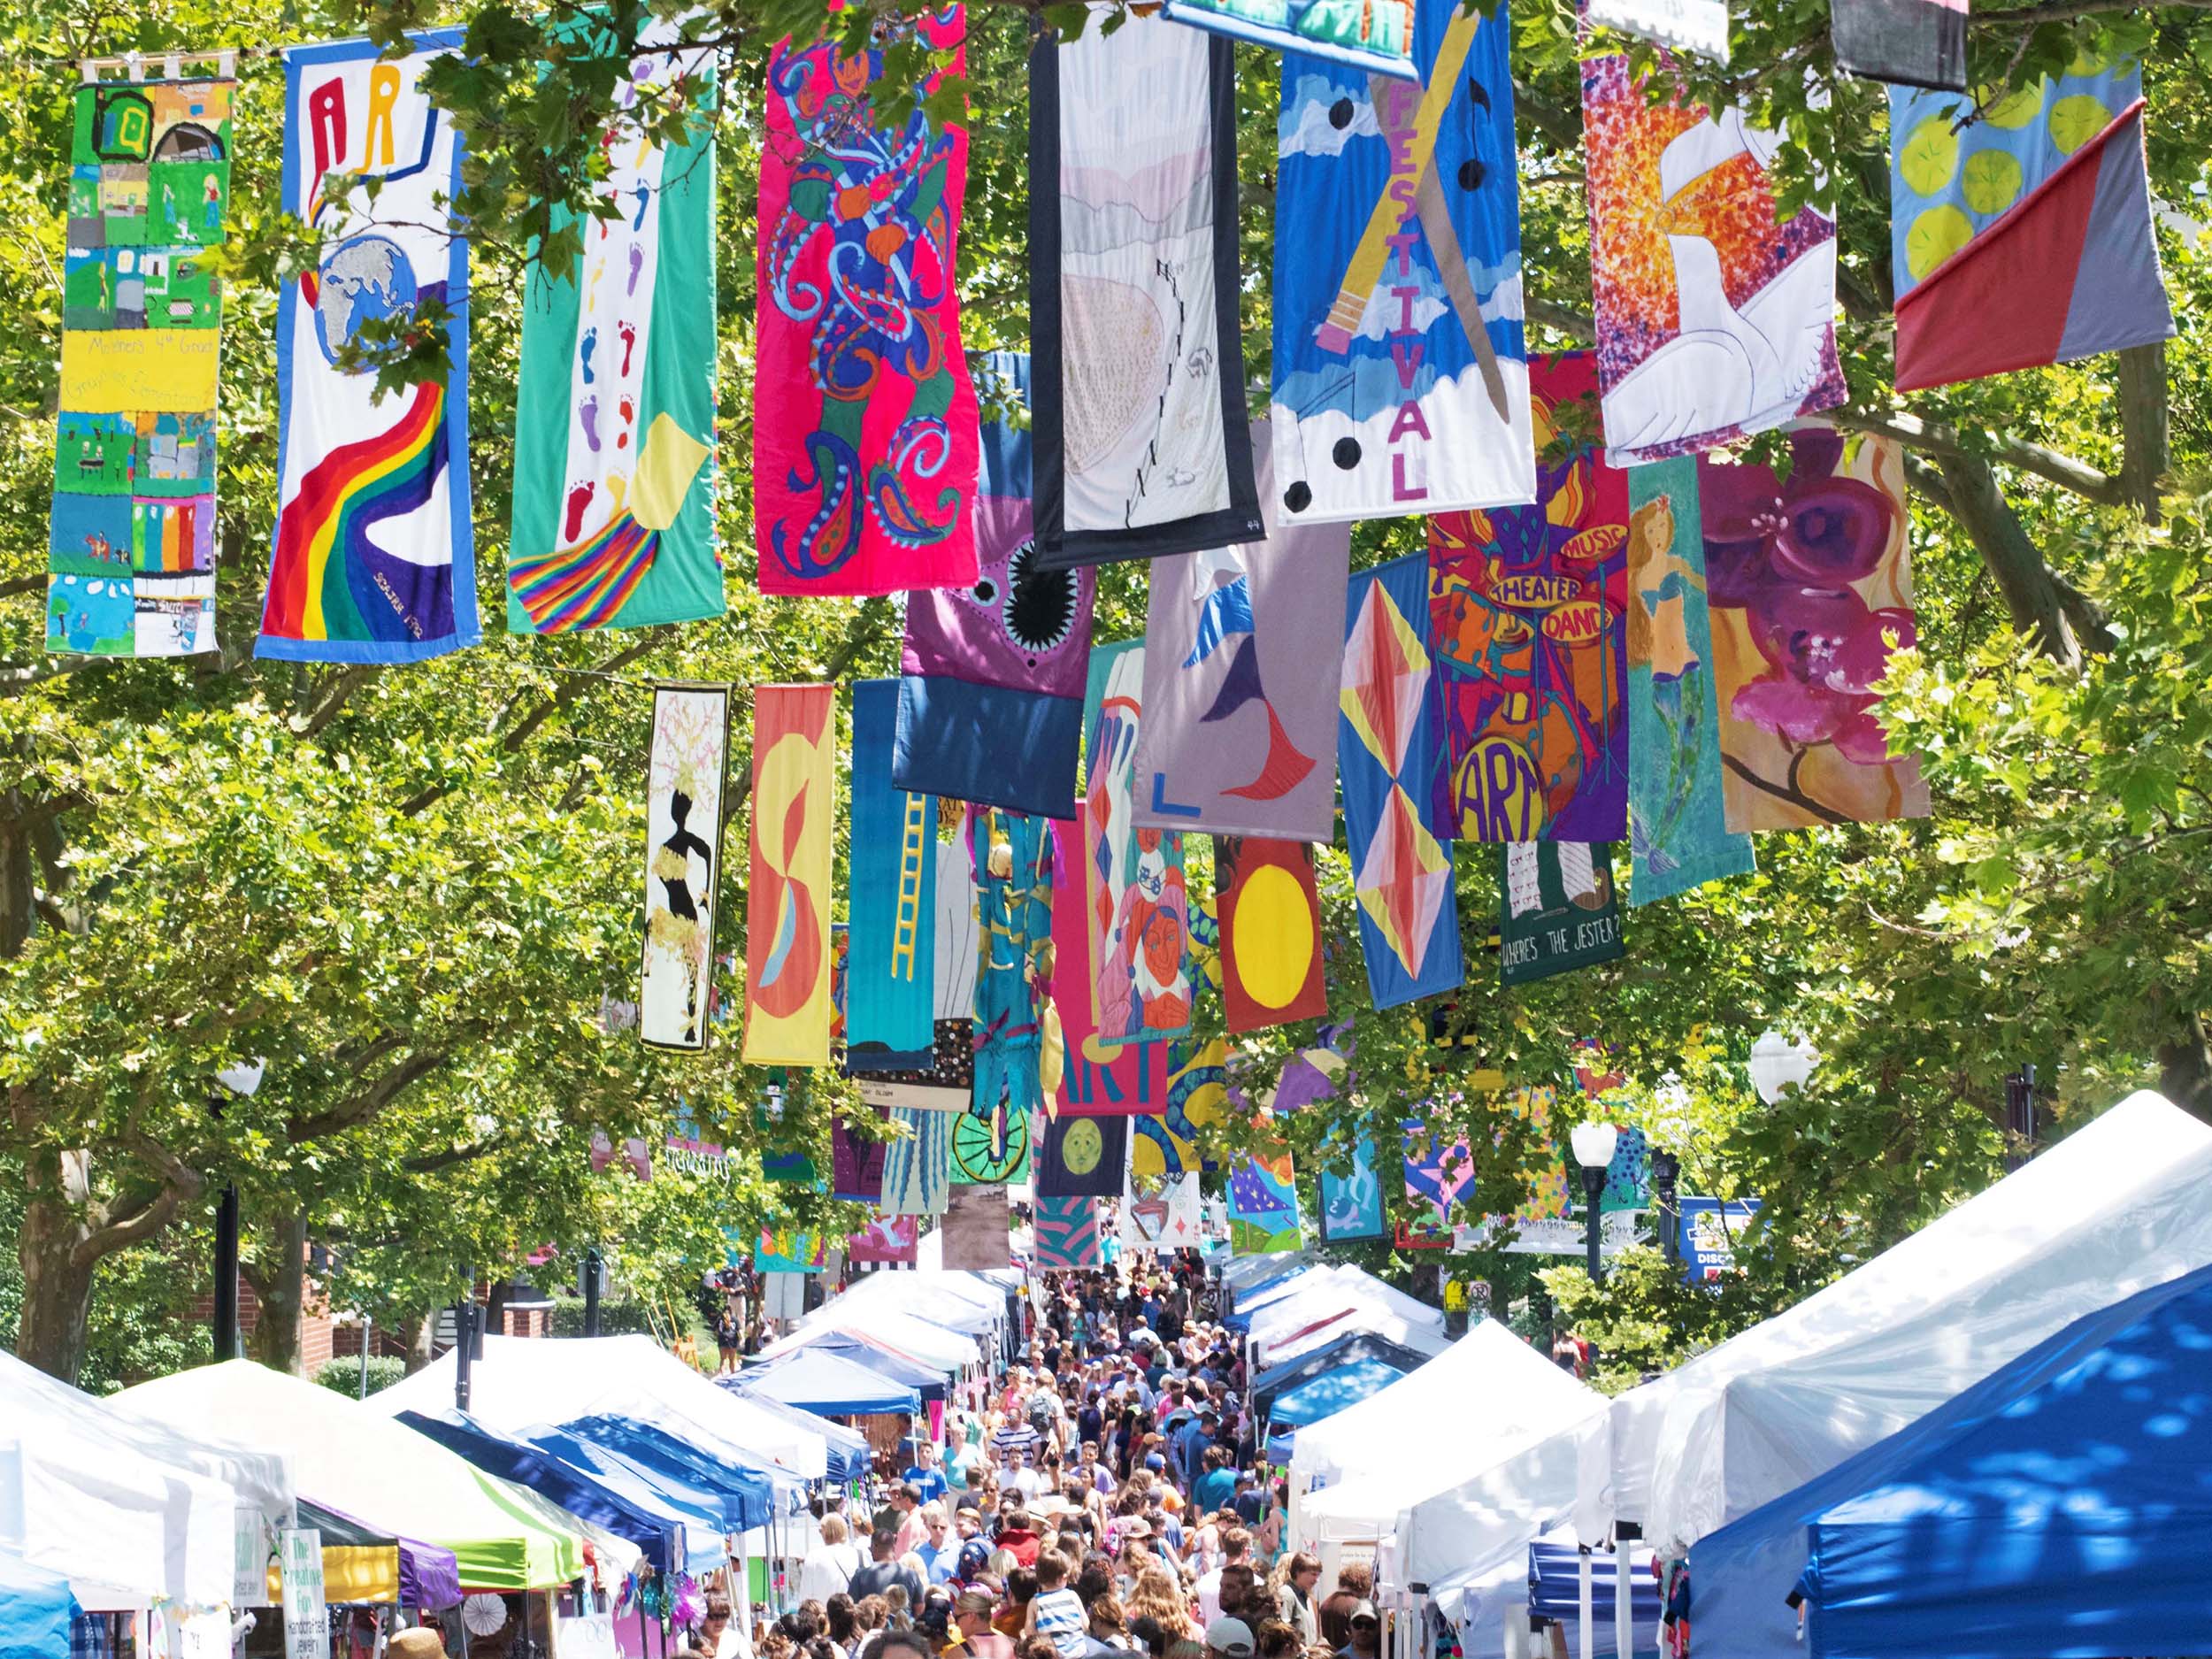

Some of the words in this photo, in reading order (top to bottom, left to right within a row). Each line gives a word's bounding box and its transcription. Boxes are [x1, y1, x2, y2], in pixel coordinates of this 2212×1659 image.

[1385, 81, 1432, 502] FESTIVAL
[1564, 526, 1625, 557] MUSIC
[1492, 579, 1580, 603] THEATER
[1457, 742, 1538, 841] ART
[1547, 927, 1570, 955] THE
